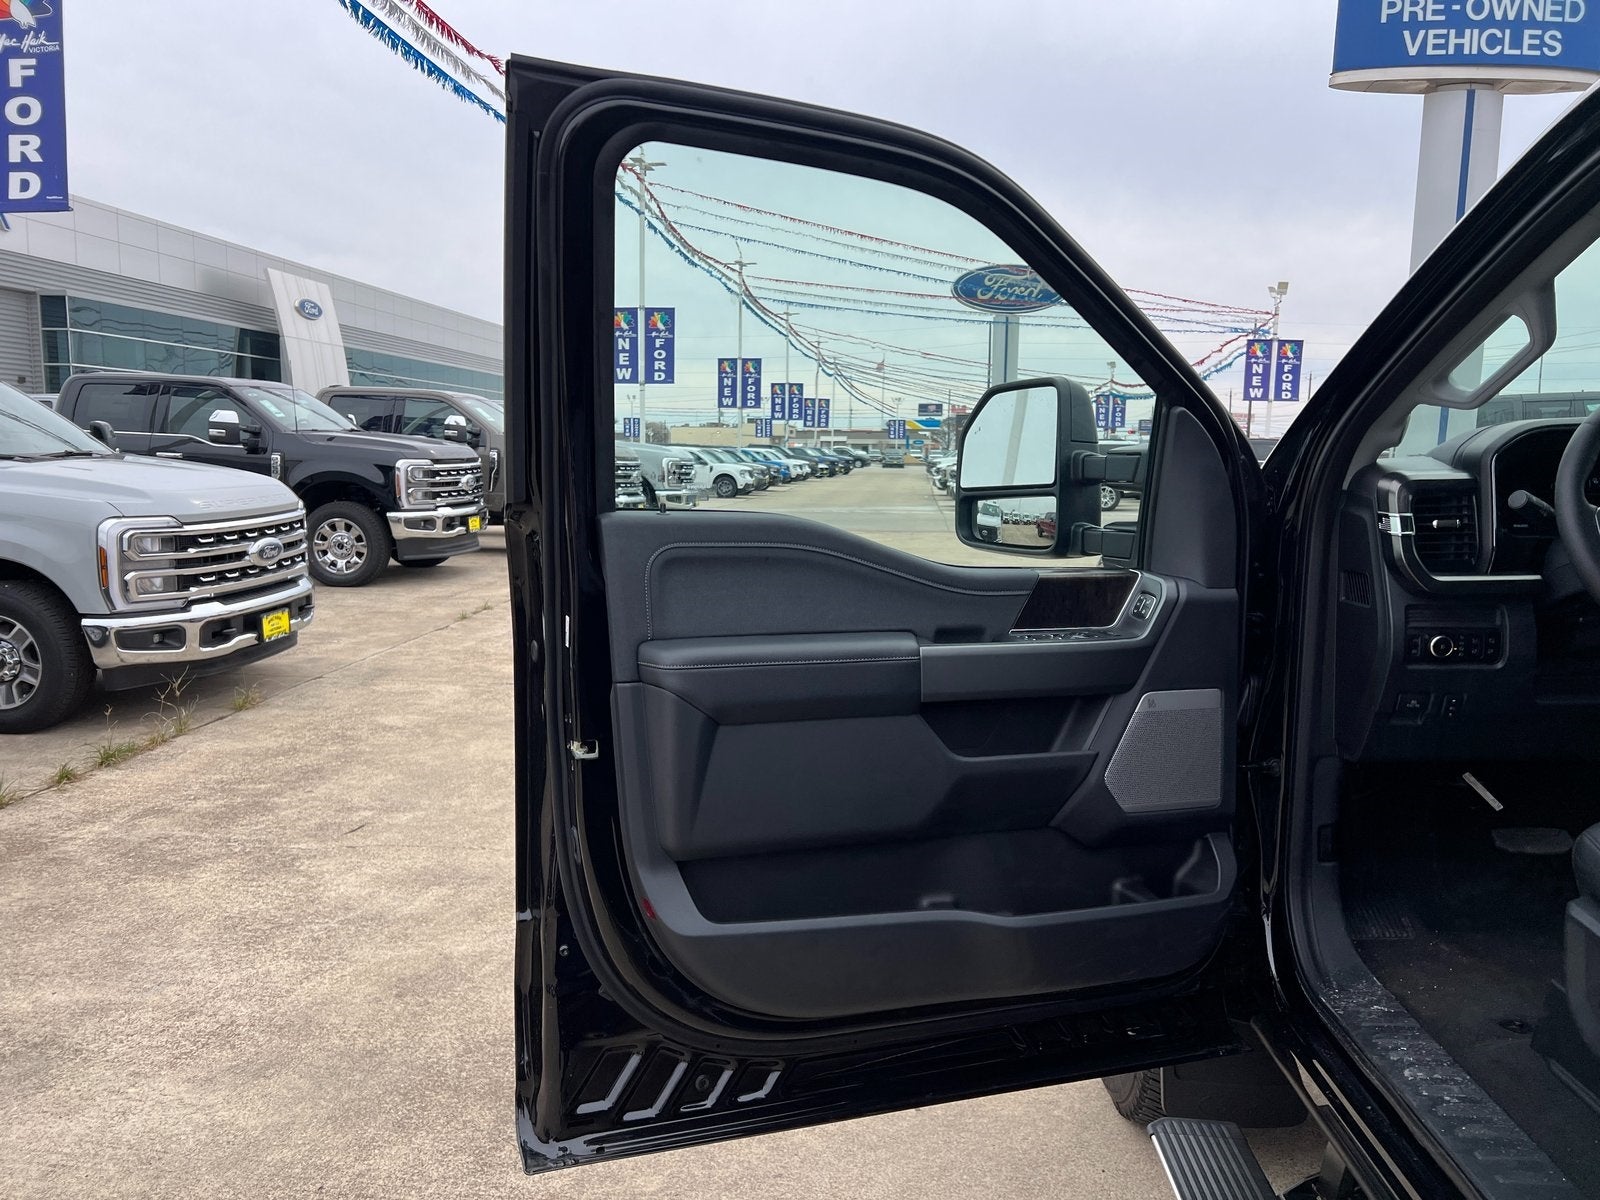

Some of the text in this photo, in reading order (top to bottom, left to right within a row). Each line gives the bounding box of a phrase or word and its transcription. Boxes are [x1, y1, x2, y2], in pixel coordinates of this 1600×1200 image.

[1380, 0, 1586, 23] PRE-OWNED
[21, 30, 59, 53] Haik
[29, 44, 60, 53] VICTORIA
[1403, 28, 1562, 57] VEHICLES
[5, 58, 43, 200] FORD
[616, 338, 632, 380] NEW
[653, 338, 666, 381] FORD
[722, 377, 733, 406] NEW
[747, 378, 755, 407] FORD
[1249, 363, 1264, 398] NEW
[1281, 364, 1293, 400] FORD
[774, 397, 782, 419] NEW
[1097, 407, 1106, 427] NEW
[262, 545, 279, 559] Ford
